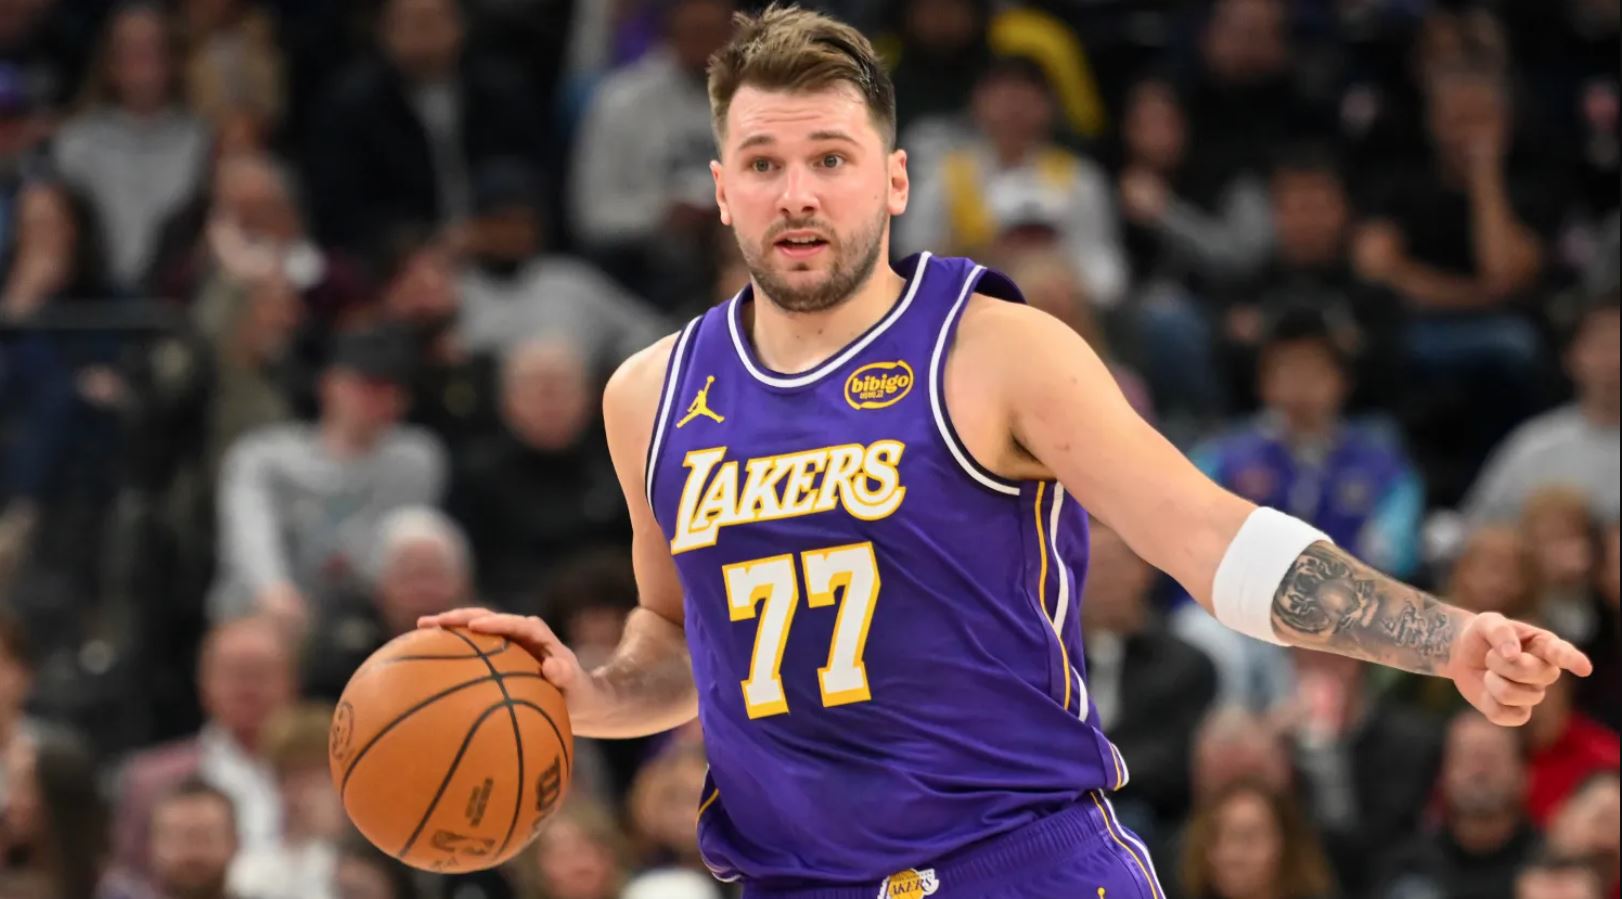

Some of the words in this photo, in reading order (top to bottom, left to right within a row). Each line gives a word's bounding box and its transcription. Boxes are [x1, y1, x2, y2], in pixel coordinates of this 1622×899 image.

[852, 373, 909, 394] bibigo
[670, 439, 907, 555] LAKERS
[721, 540, 882, 720] 77
